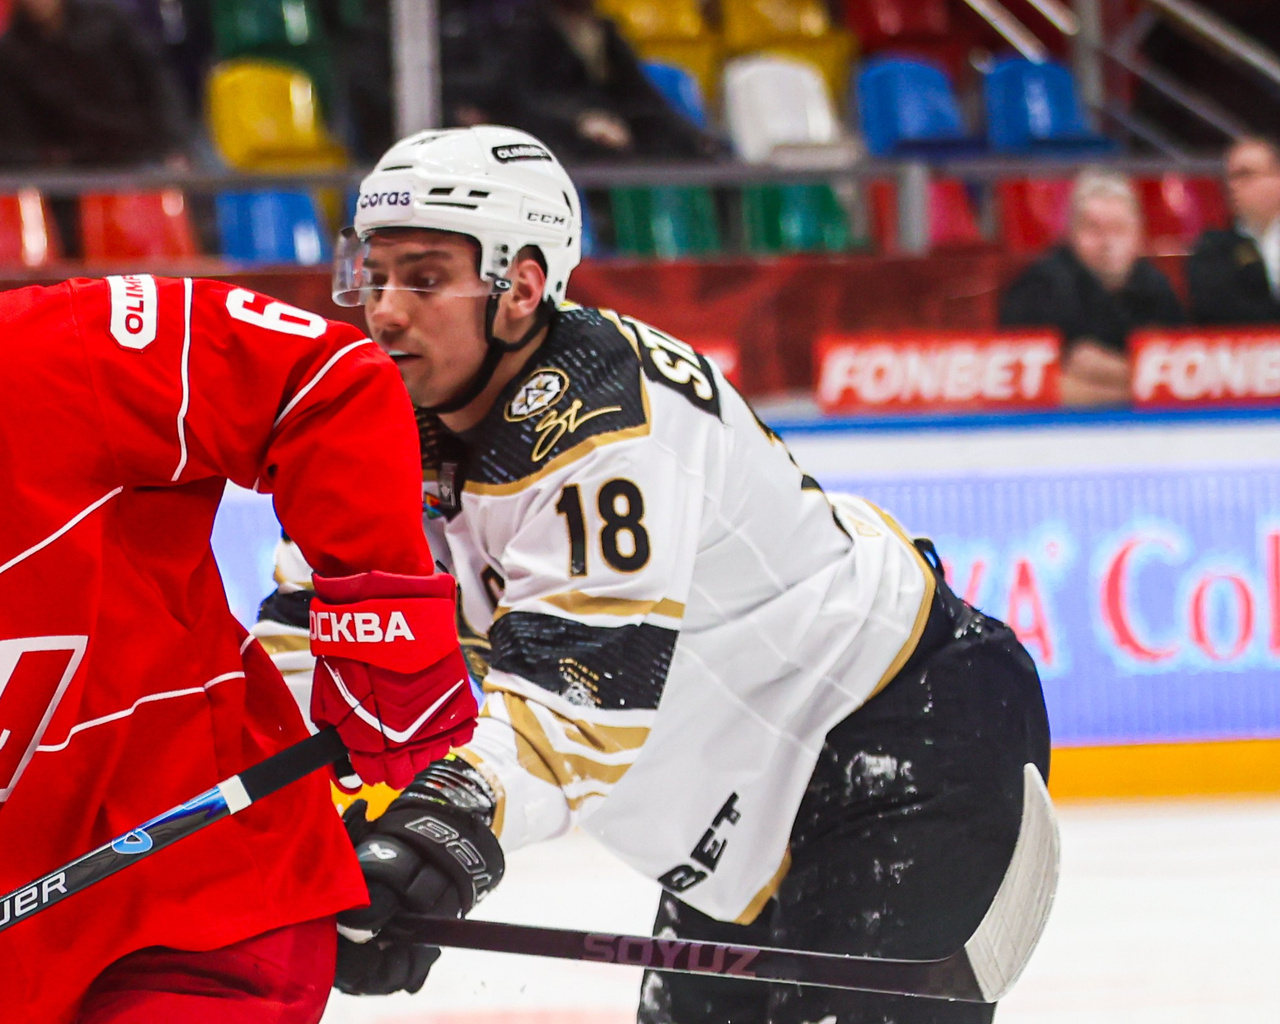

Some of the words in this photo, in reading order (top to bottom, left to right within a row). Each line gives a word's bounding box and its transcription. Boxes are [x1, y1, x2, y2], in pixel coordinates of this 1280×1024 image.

[526, 211, 566, 226] CCM
[225, 287, 328, 339] 6
[824, 338, 1055, 405] FONBET
[556, 477, 651, 578] 18
[581, 933, 764, 979] SOYUZ
